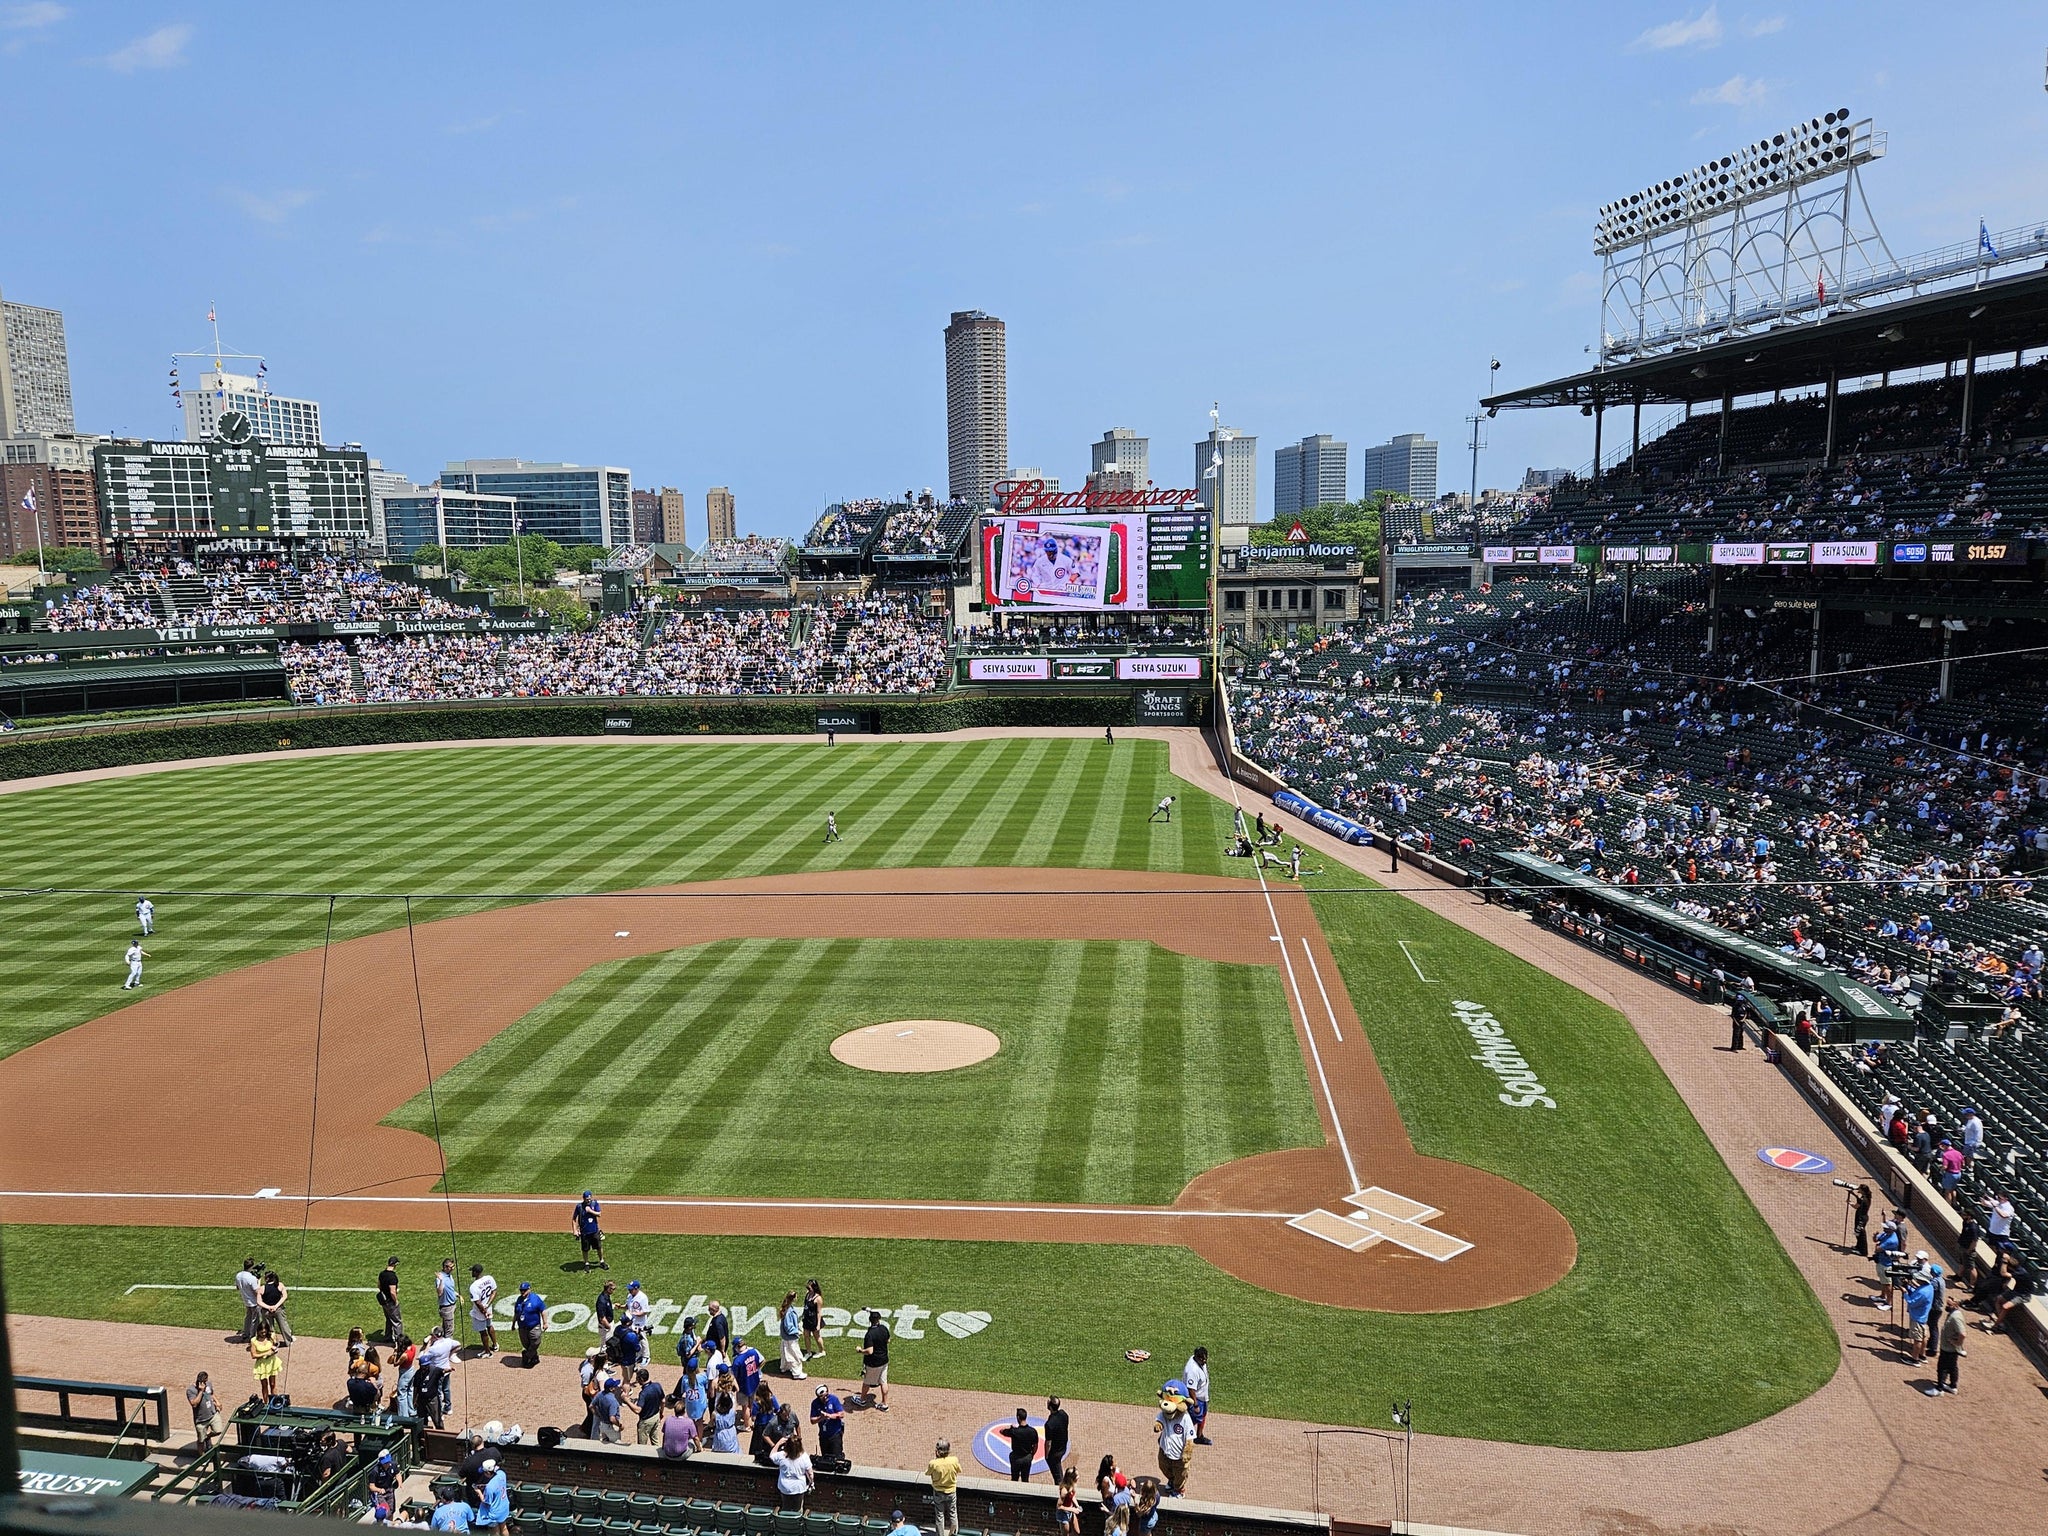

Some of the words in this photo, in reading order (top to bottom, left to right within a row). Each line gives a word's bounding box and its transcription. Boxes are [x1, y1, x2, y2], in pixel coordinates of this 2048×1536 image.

[151, 444, 209, 455] NATIONAL
[265, 447, 319, 457] AMERICAN
[994, 478, 1200, 514] Budweiser
[1240, 544, 1304, 561] Benjamin
[1309, 543, 1354, 556] Moore
[1606, 547, 1639, 561] STARTING
[1645, 546, 1672, 561] LINEUP
[1719, 547, 1735, 557] SEIYA
[1735, 547, 1757, 556] SUZUKI
[1786, 551, 1805, 559] #27
[1822, 546, 1840, 556] SEIYA
[1842, 545, 1867, 556] SUZUKI
[1968, 545, 2007, 560] $11,557
[1931, 551, 1955, 561] TOTAL
[685, 576, 758, 585] WRIGLEYROOFTOPS.COM
[1774, 600, 1788, 608] eero
[1788, 600, 1802, 608] suite
[1803, 600, 1817, 609] level
[333, 621, 381, 630] GRAINGER
[491, 619, 535, 629] Advocate
[155, 628, 197, 641] YETI
[219, 627, 275, 638] tastytrade
[983, 664, 1005, 674] SEIYA
[1007, 664, 1036, 674] SUZUKI
[1076, 665, 1104, 674] #27
[1131, 663, 1155, 673] SEIYA
[1156, 663, 1187, 673] SUZUKI
[1144, 696, 1182, 705] DRAFT
[607, 719, 630, 728] Hefty
[278, 738, 291, 746] 400
[1451, 1010, 1557, 1109] Southwest
[481, 1285, 492, 1301] 22
[745, 1362, 759, 1377] 21
[687, 1388, 700, 1401] 25
